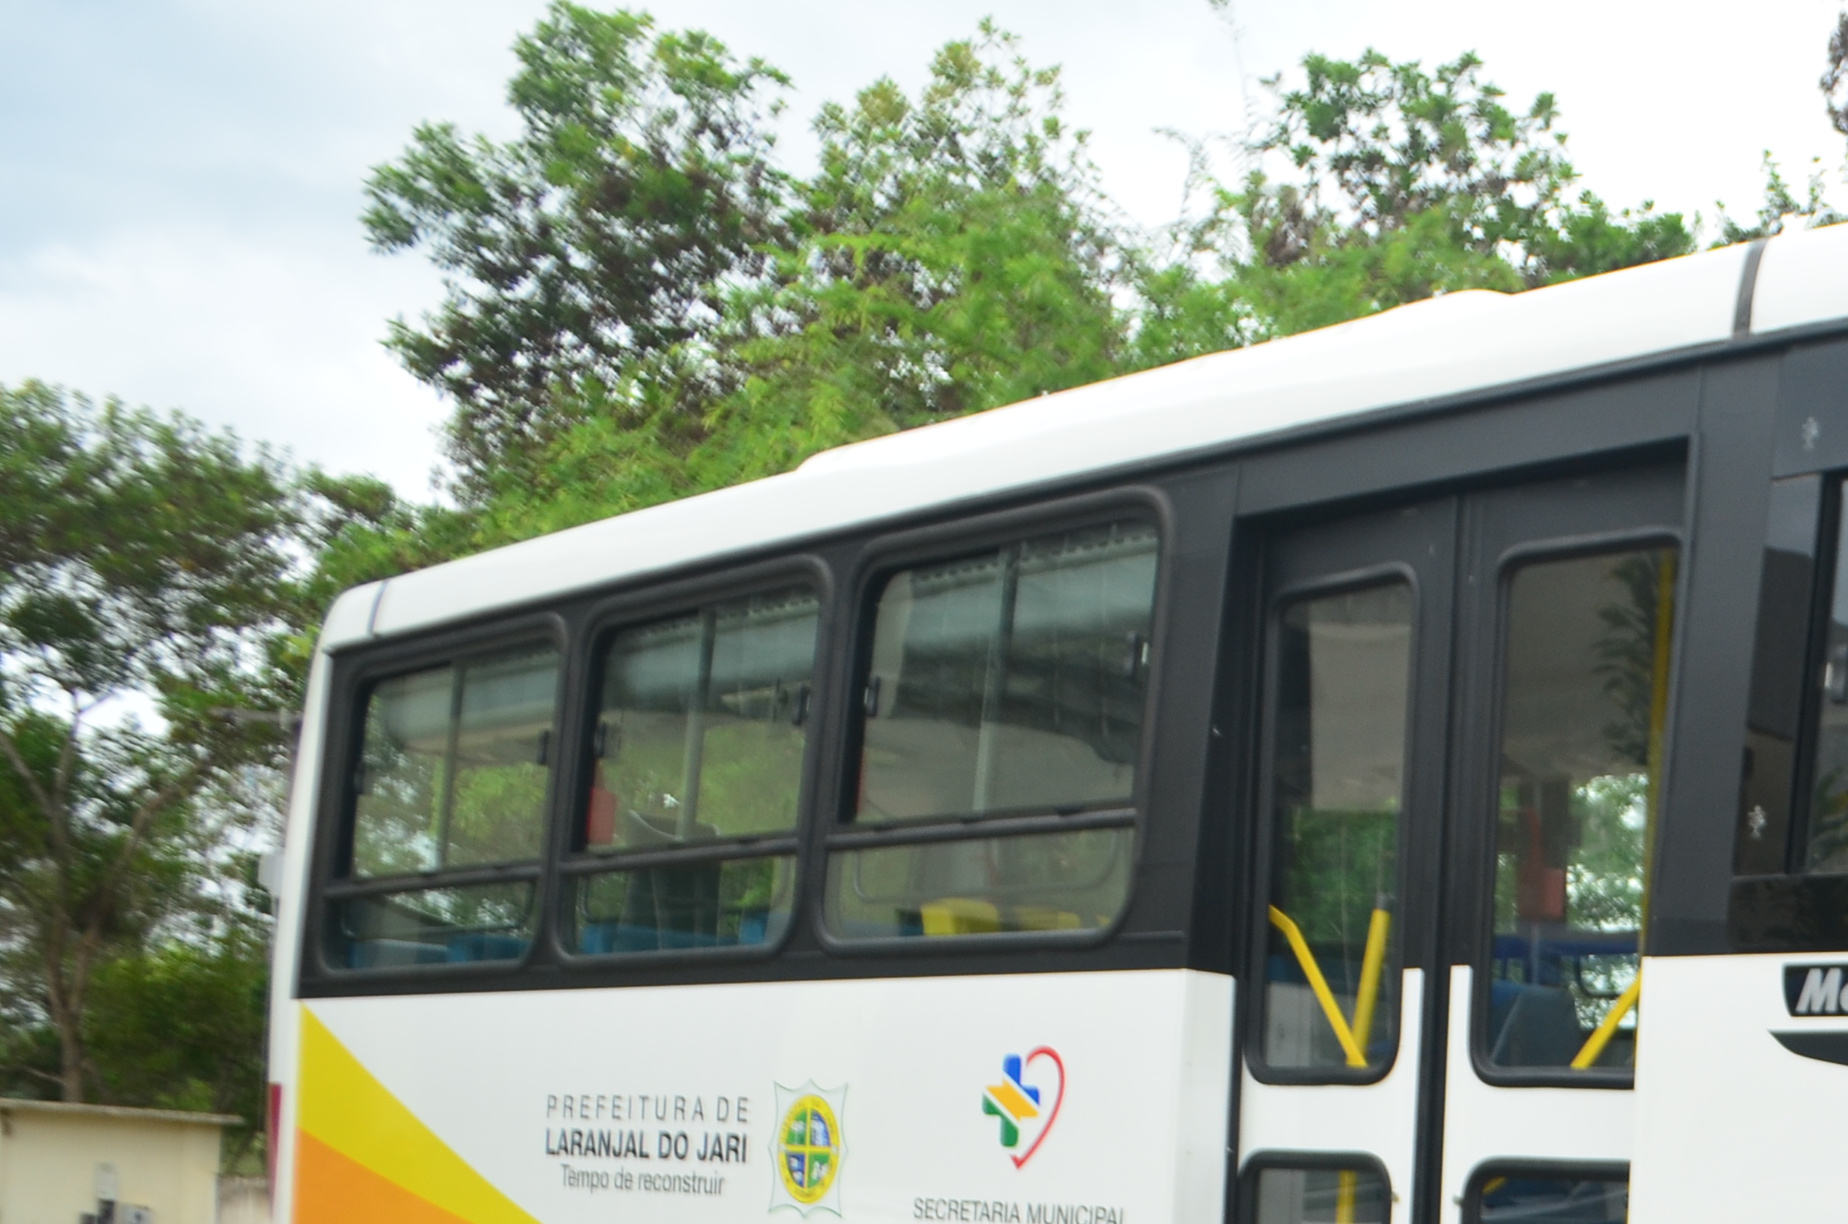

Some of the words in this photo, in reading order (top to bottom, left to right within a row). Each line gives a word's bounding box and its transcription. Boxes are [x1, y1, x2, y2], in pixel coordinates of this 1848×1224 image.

[546, 1094, 704, 1121] PREFEITURA
[716, 1096, 749, 1123] DE
[545, 1127, 650, 1158] LARANJAL
[659, 1130, 689, 1160] DO
[697, 1131, 748, 1163] JARI
[560, 1163, 609, 1193] Tempo
[614, 1166, 633, 1190] de
[638, 1170, 725, 1195] reconstruir
[913, 1197, 1020, 1223] SECRETARIA
